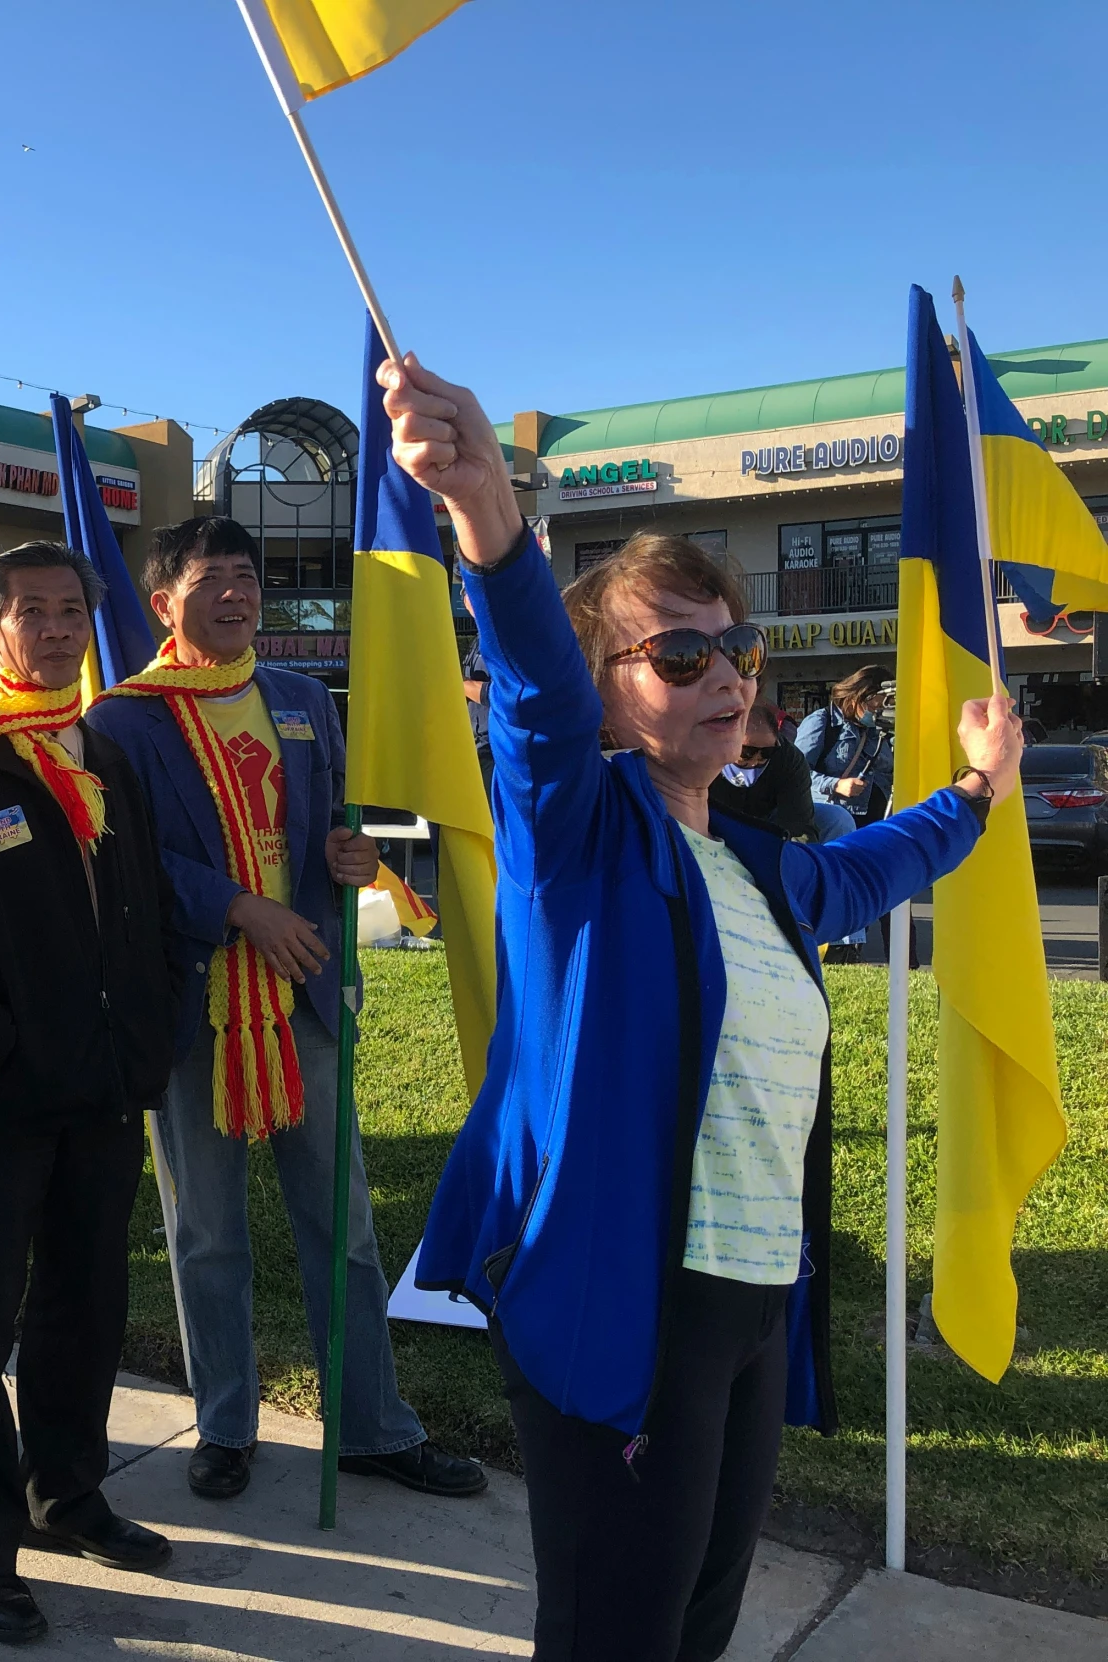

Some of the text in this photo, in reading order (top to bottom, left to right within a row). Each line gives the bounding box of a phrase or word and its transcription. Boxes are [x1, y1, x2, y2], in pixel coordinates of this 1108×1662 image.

[741, 433, 900, 477] PURE AUDIO
[10, 465, 40, 495] PHAN
[43, 471, 60, 496] MD
[102, 477, 116, 486] LITTLE
[559, 459, 657, 488] ANGEL
[102, 487, 138, 510] HOME
[561, 488, 588, 499] DRIVING
[589, 485, 614, 496] SCHOOL
[621, 482, 655, 493] SERVICES
[792, 536, 812, 547] HI-FI
[789, 547, 815, 558] AUDIO
[784, 558, 818, 570] KARAOKE
[316, 635, 351, 657] MA
[267, 660, 288, 668] Home
[289, 659, 322, 669] Shopping
